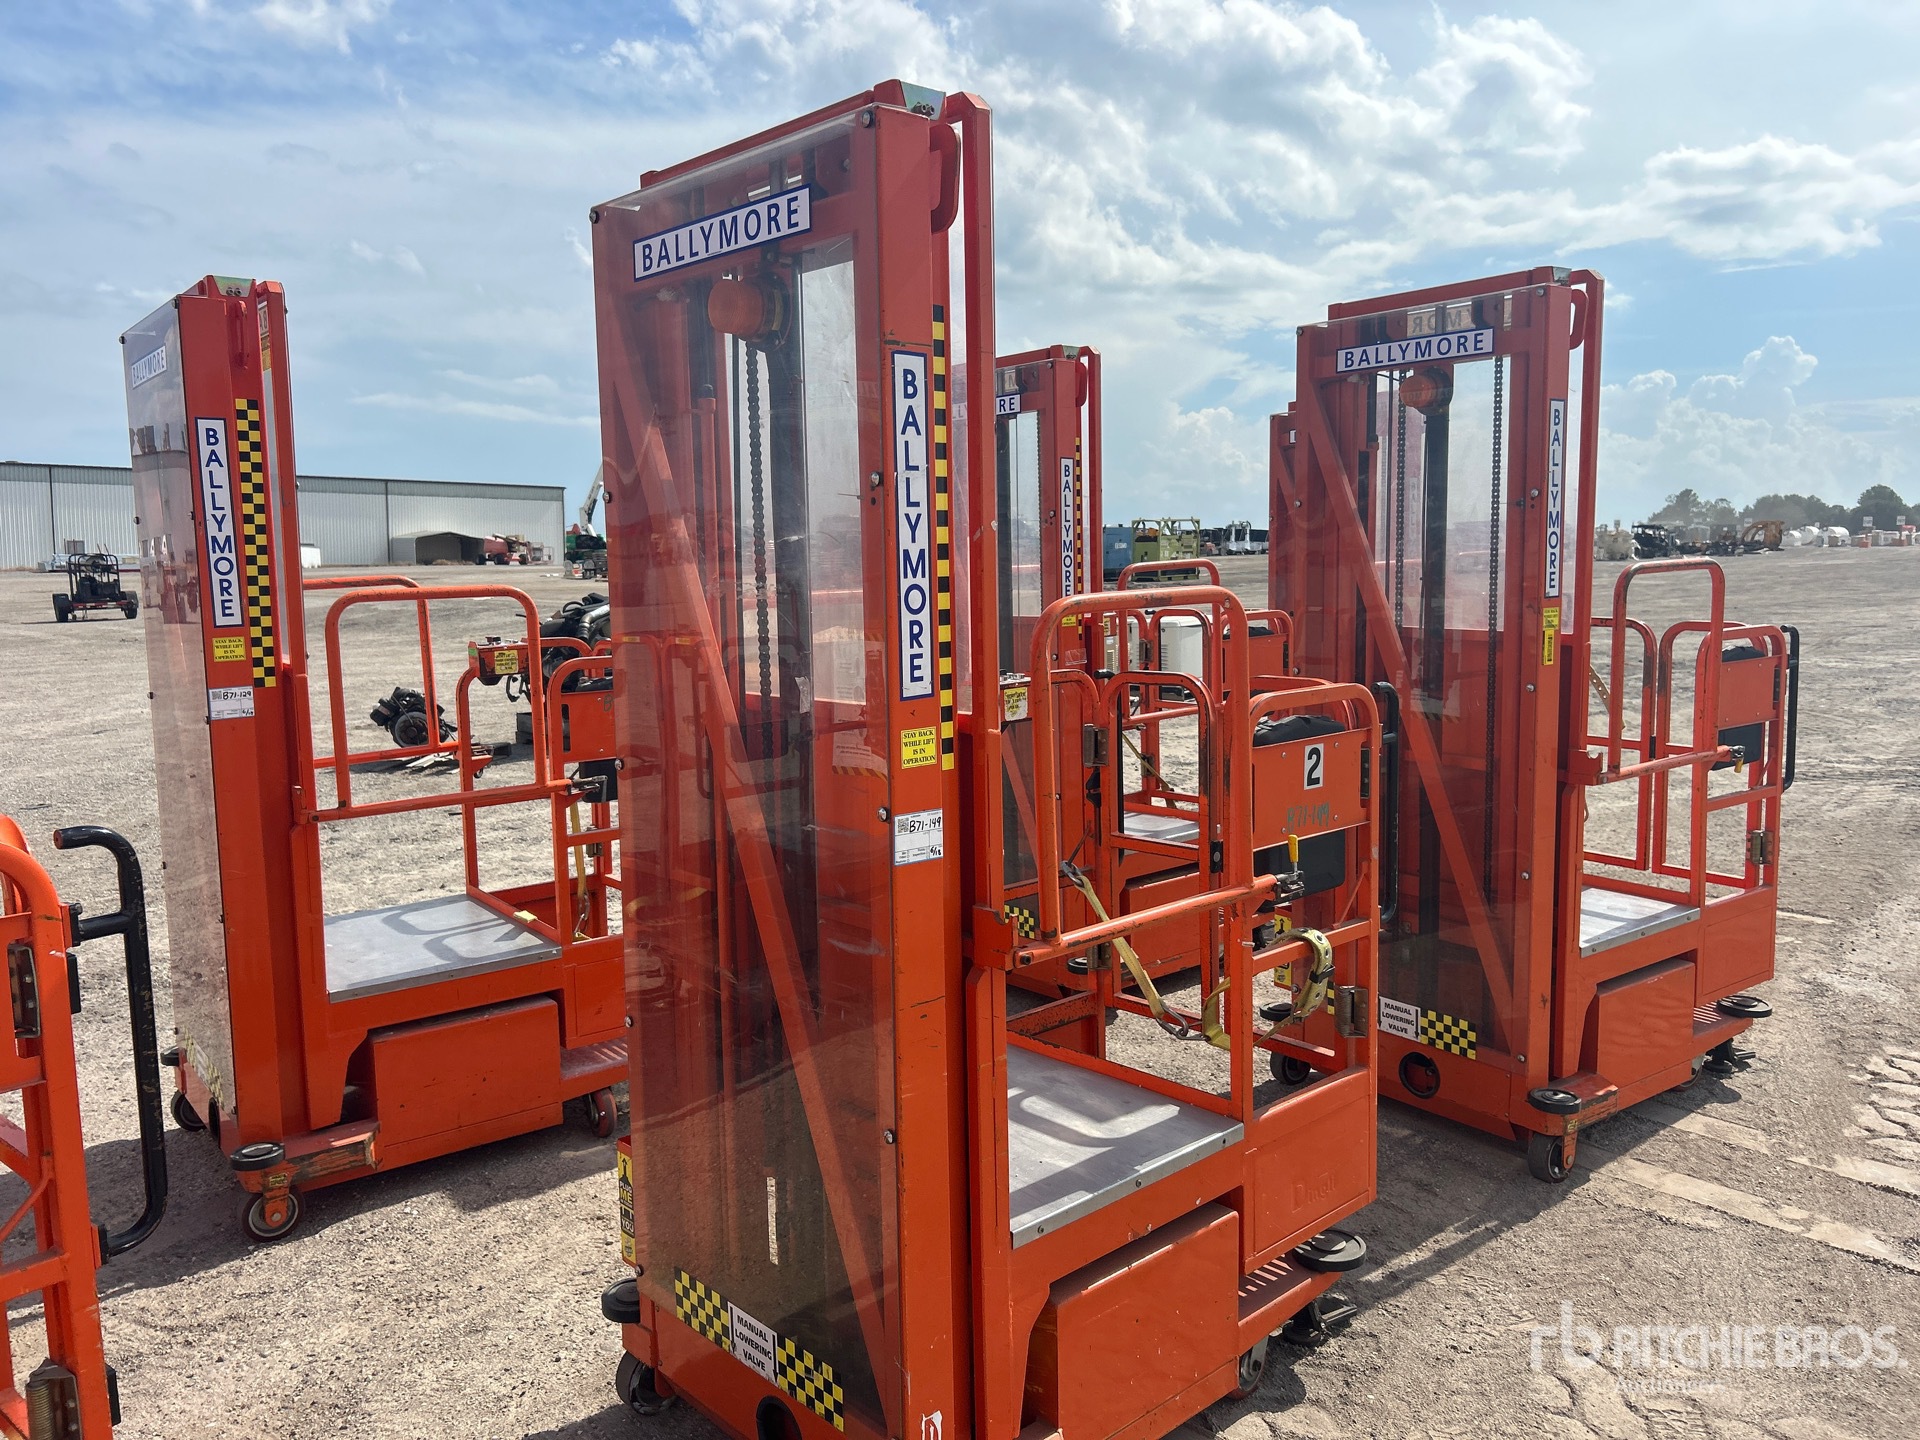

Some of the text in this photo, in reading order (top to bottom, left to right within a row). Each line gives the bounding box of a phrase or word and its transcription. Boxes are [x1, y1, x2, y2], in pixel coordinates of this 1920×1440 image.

[641, 195, 800, 273] BALLYMORE
[1344, 332, 1485, 369] BALLYMORE
[132, 349, 165, 385] BALLYMORE
[1548, 408, 1562, 589] BALLYMORE
[204, 427, 234, 618] BALLYMORE
[900, 368, 926, 683] BALLYMORE
[1062, 464, 1073, 597] BALLYMORE
[903, 740, 922, 748] WHILE
[918, 730, 934, 738] BACK
[903, 755, 936, 765] OPERATION
[1306, 746, 1321, 787] 2
[909, 816, 942, 833] B71-149
[1382, 1011, 1415, 1027] LOWERING
[1384, 1002, 1412, 1015] MANUAL
[1388, 1023, 1408, 1034] VALVE
[735, 1327, 772, 1361] LOWERING
[737, 1314, 769, 1343] MANUAL
[742, 1348, 766, 1372] VALVE
